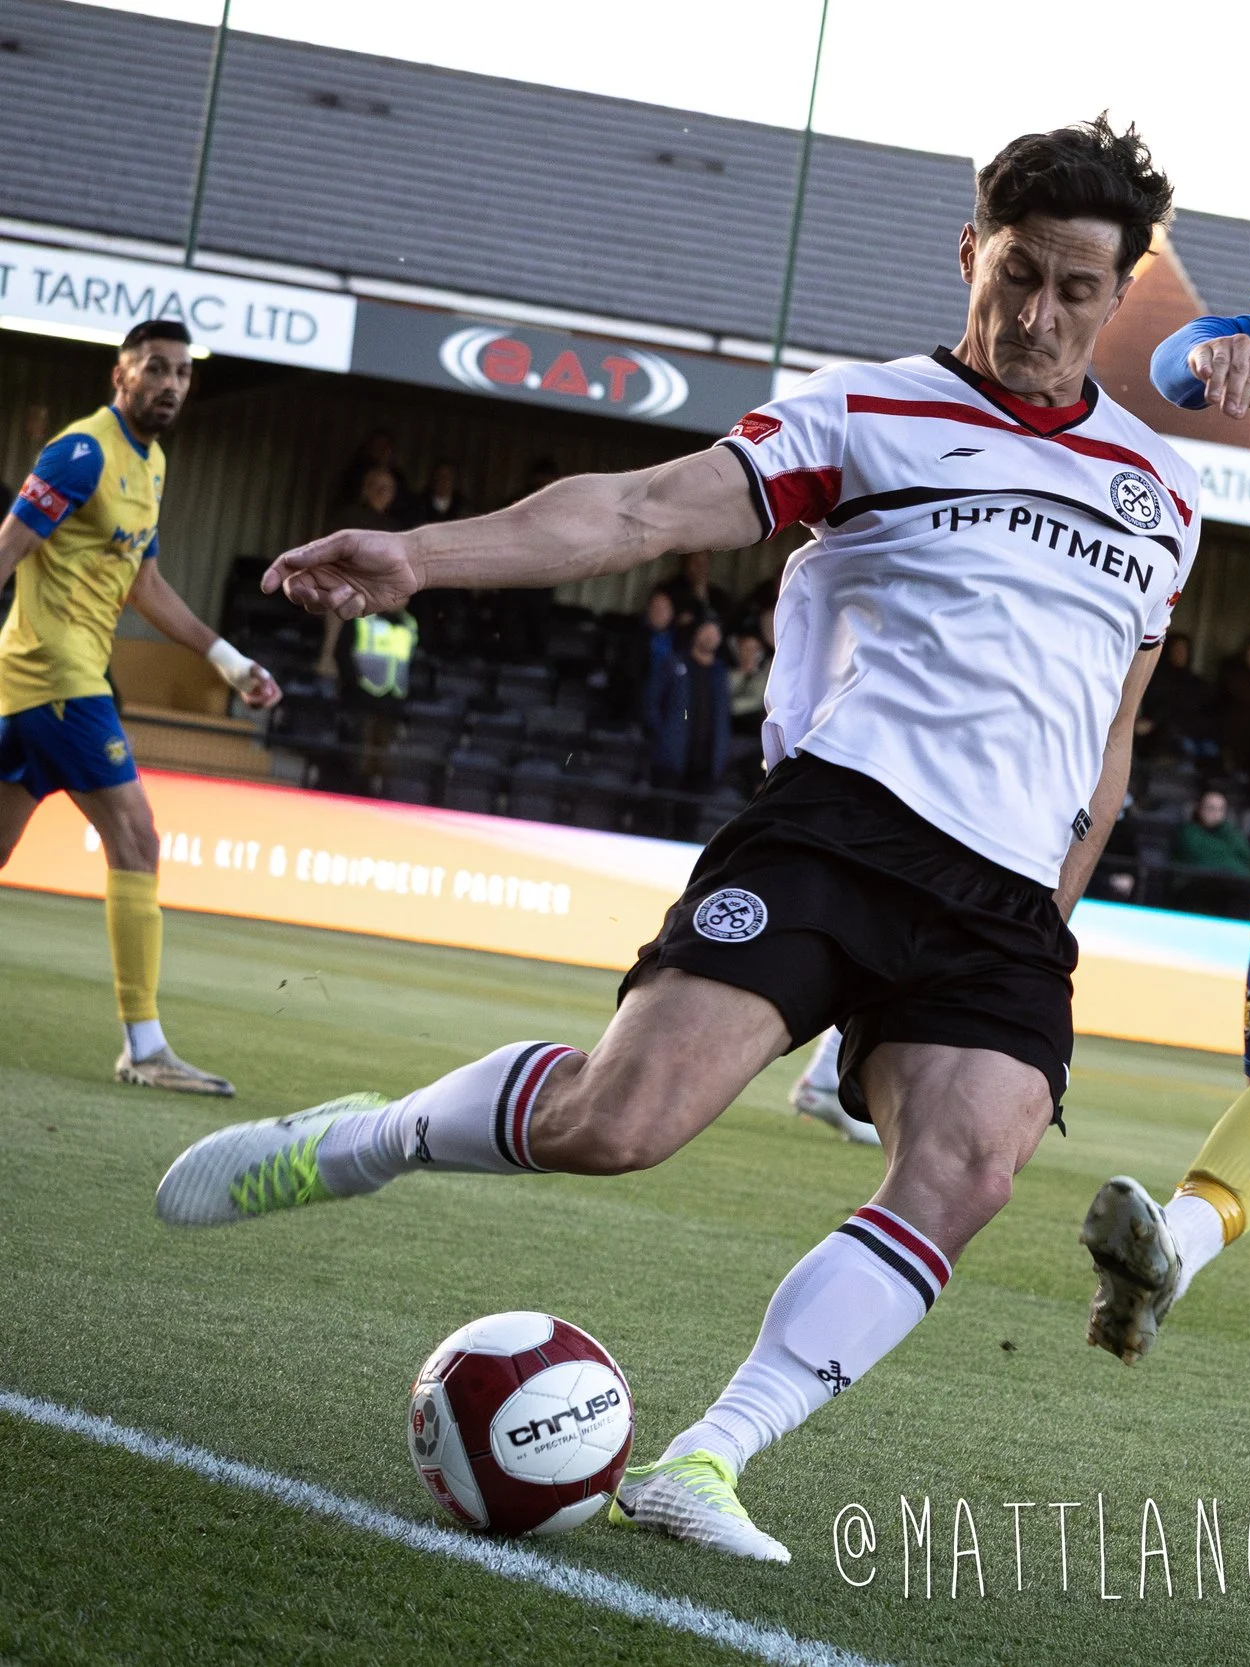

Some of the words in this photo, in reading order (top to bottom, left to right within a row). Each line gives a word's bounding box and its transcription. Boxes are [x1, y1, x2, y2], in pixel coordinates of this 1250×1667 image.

[32, 269, 227, 332] TARMAC
[245, 302, 319, 346] LTD
[1009, 506, 1154, 594] PITMEN
[214, 838, 261, 871] KIT
[296, 847, 445, 898] EQUIPMENT
[453, 869, 571, 915] PARTNER
[534, 1432, 579, 1454] SPECTRAL
